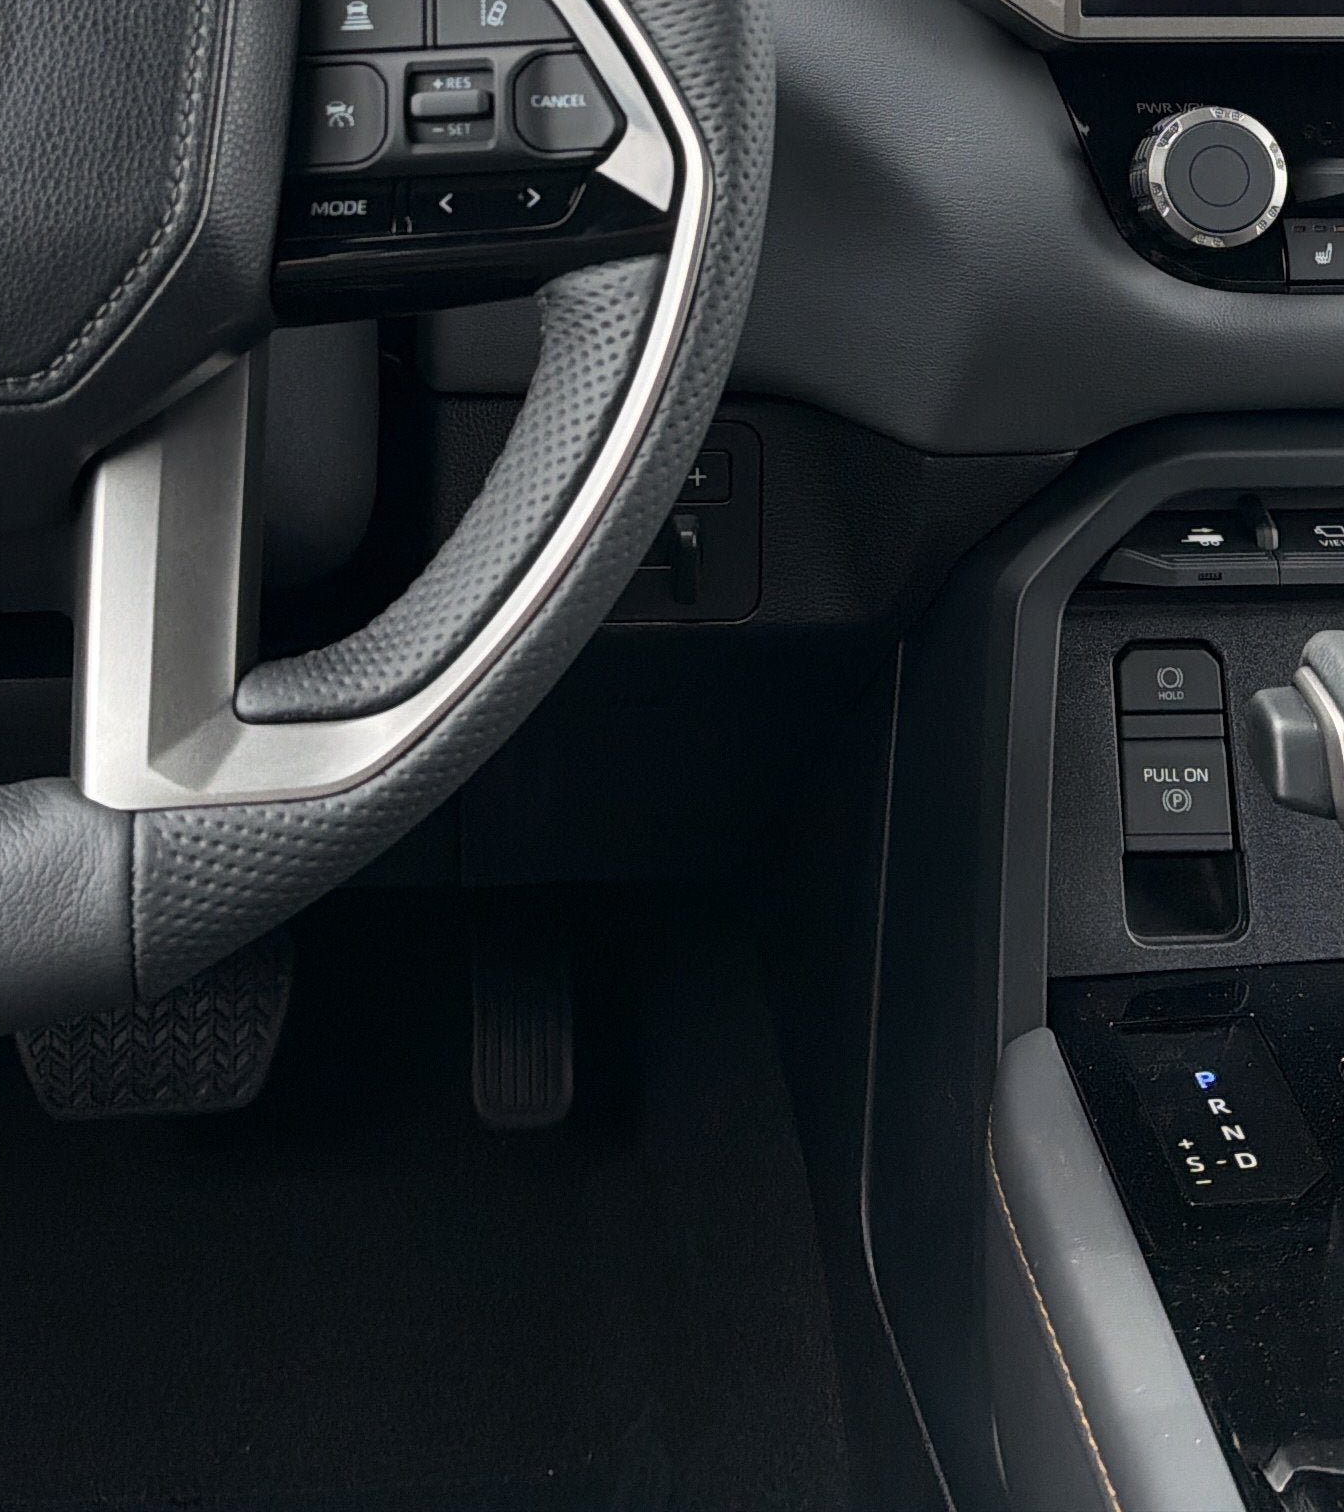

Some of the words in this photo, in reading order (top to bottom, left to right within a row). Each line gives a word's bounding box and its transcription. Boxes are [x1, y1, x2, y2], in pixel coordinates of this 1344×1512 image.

[530, 94, 587, 109] CANCEL
[1136, 102, 1174, 115] PWR
[311, 200, 368, 217] MODE
[1158, 691, 1185, 701] HOLD
[1143, 768, 1180, 783] PULL
[1183, 768, 1209, 783] ON
[1194, 1070, 1217, 1089] P
[1207, 1098, 1232, 1115] R
[1221, 1124, 1246, 1141] N
[1234, 1152, 1258, 1169] D
